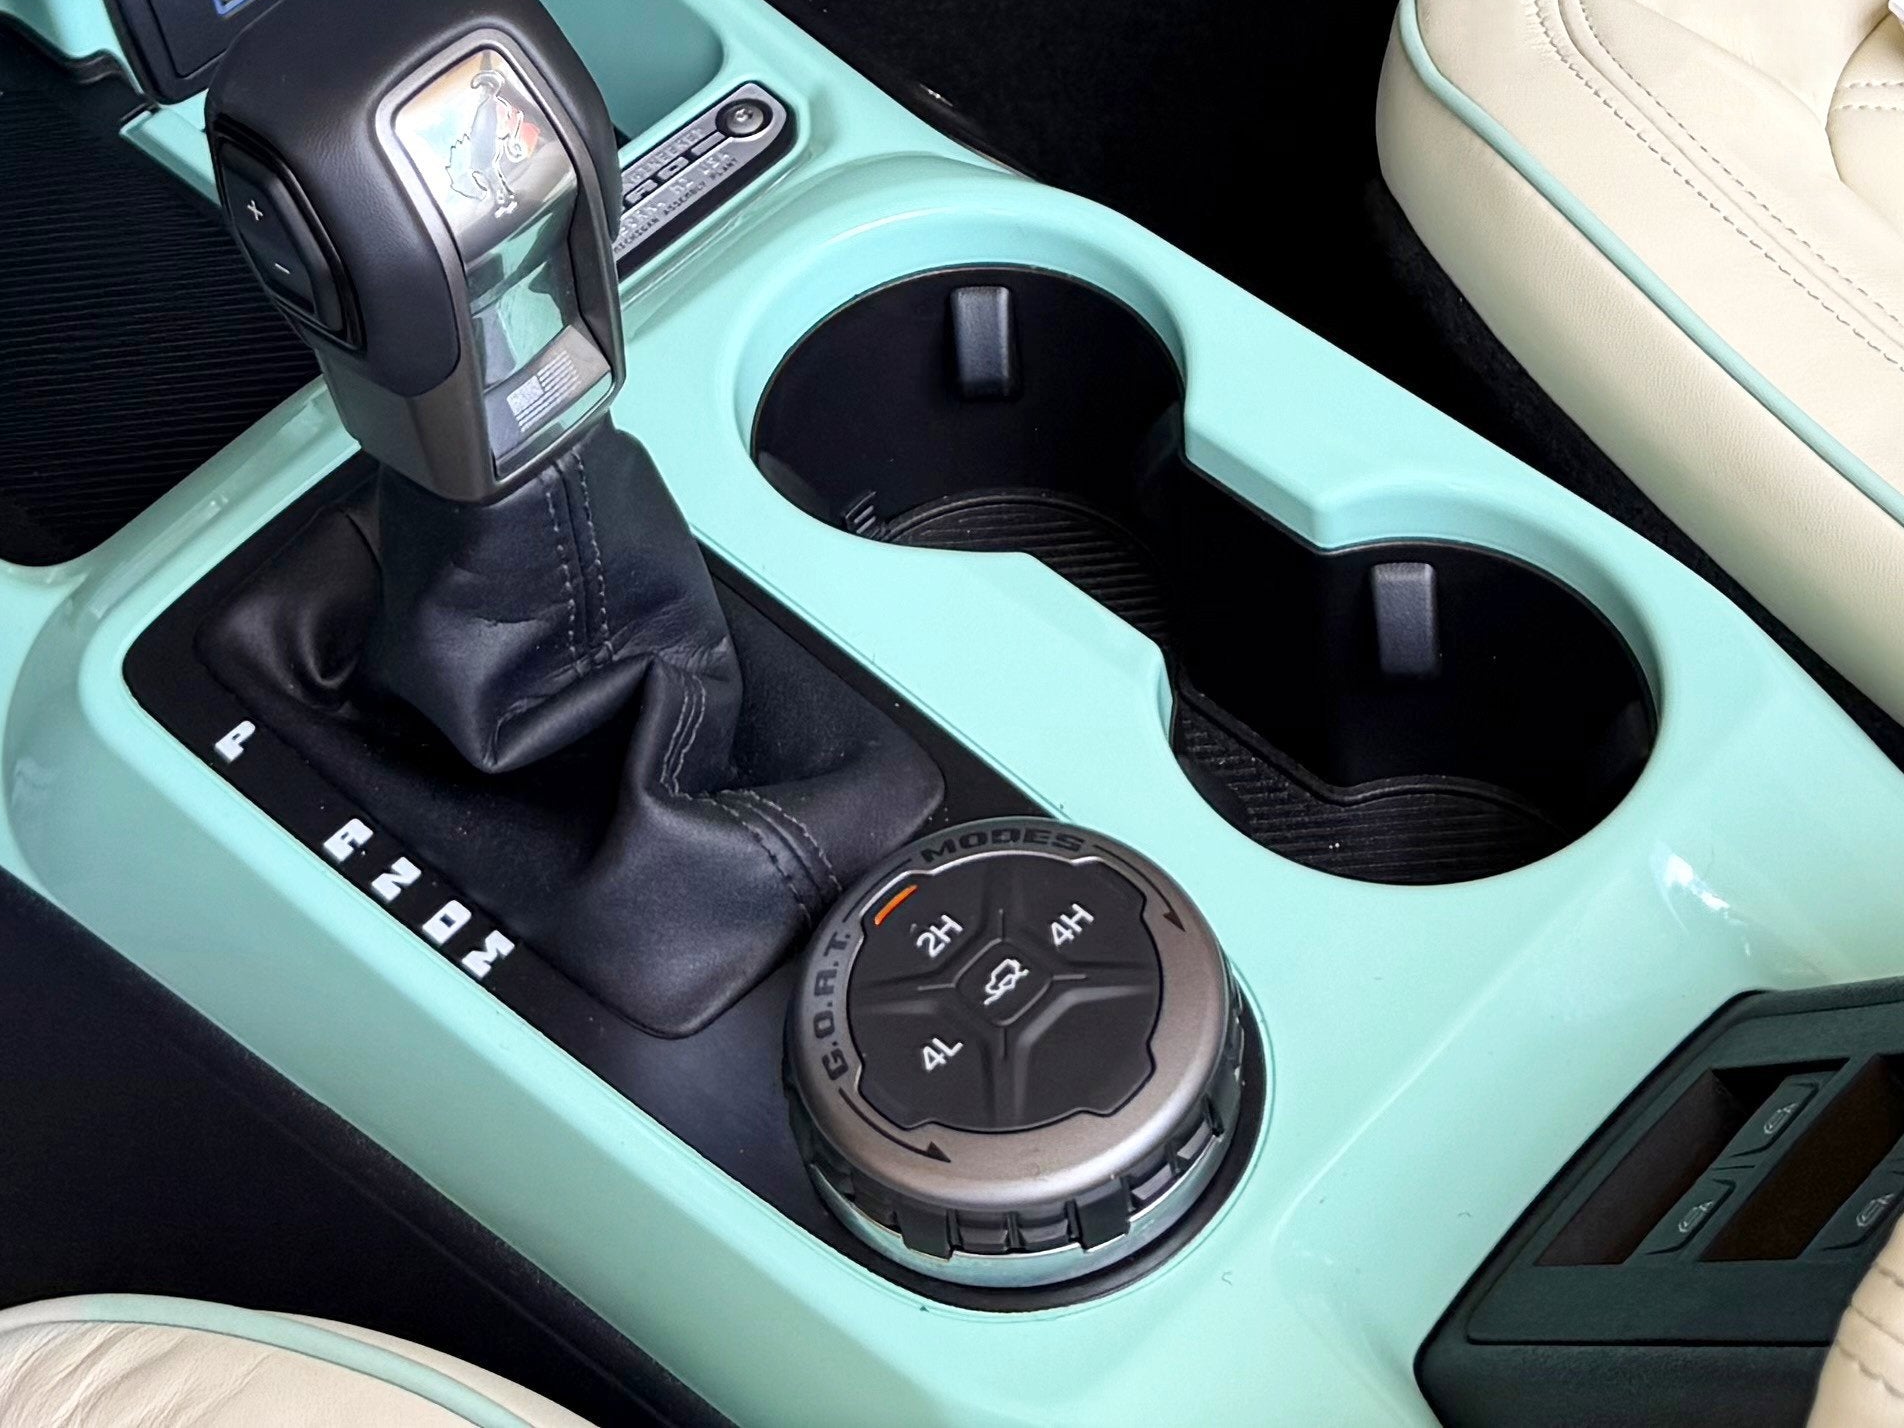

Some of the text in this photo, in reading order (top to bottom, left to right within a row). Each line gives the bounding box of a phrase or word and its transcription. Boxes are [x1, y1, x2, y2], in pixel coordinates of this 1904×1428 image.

[215, 720, 256, 763] P
[324, 818, 374, 862] R
[371, 856, 422, 902] N
[921, 825, 1087, 862] MODES
[916, 913, 964, 959] 2H
[1047, 902, 1095, 948] 4H
[920, 1035, 964, 1073] 4L
